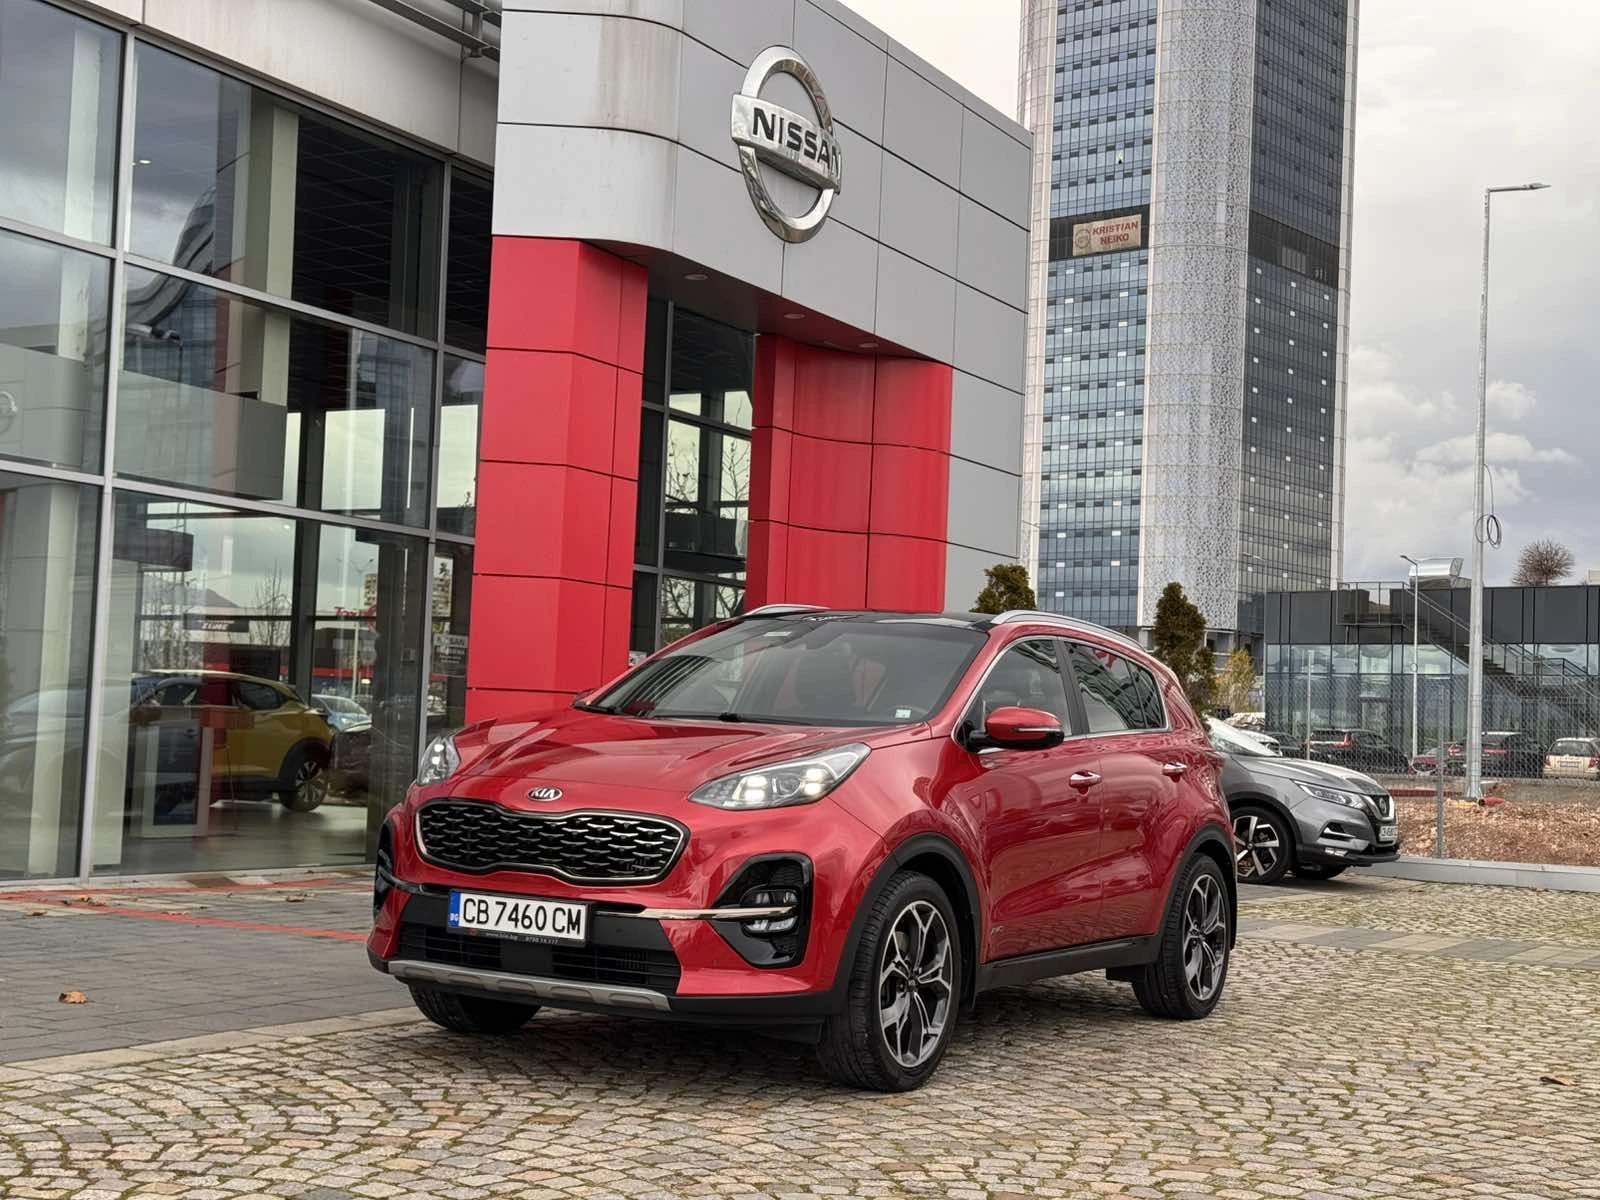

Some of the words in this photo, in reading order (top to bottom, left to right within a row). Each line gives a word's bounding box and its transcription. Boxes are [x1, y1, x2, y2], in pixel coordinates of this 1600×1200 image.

[752, 107, 840, 177] NISSAN
[1092, 220, 1138, 235] KRISTIAN
[1100, 233, 1129, 244] NEIKO
[531, 788, 555, 798] KIA
[494, 901, 547, 931] 7460
[552, 907, 582, 935] CM
